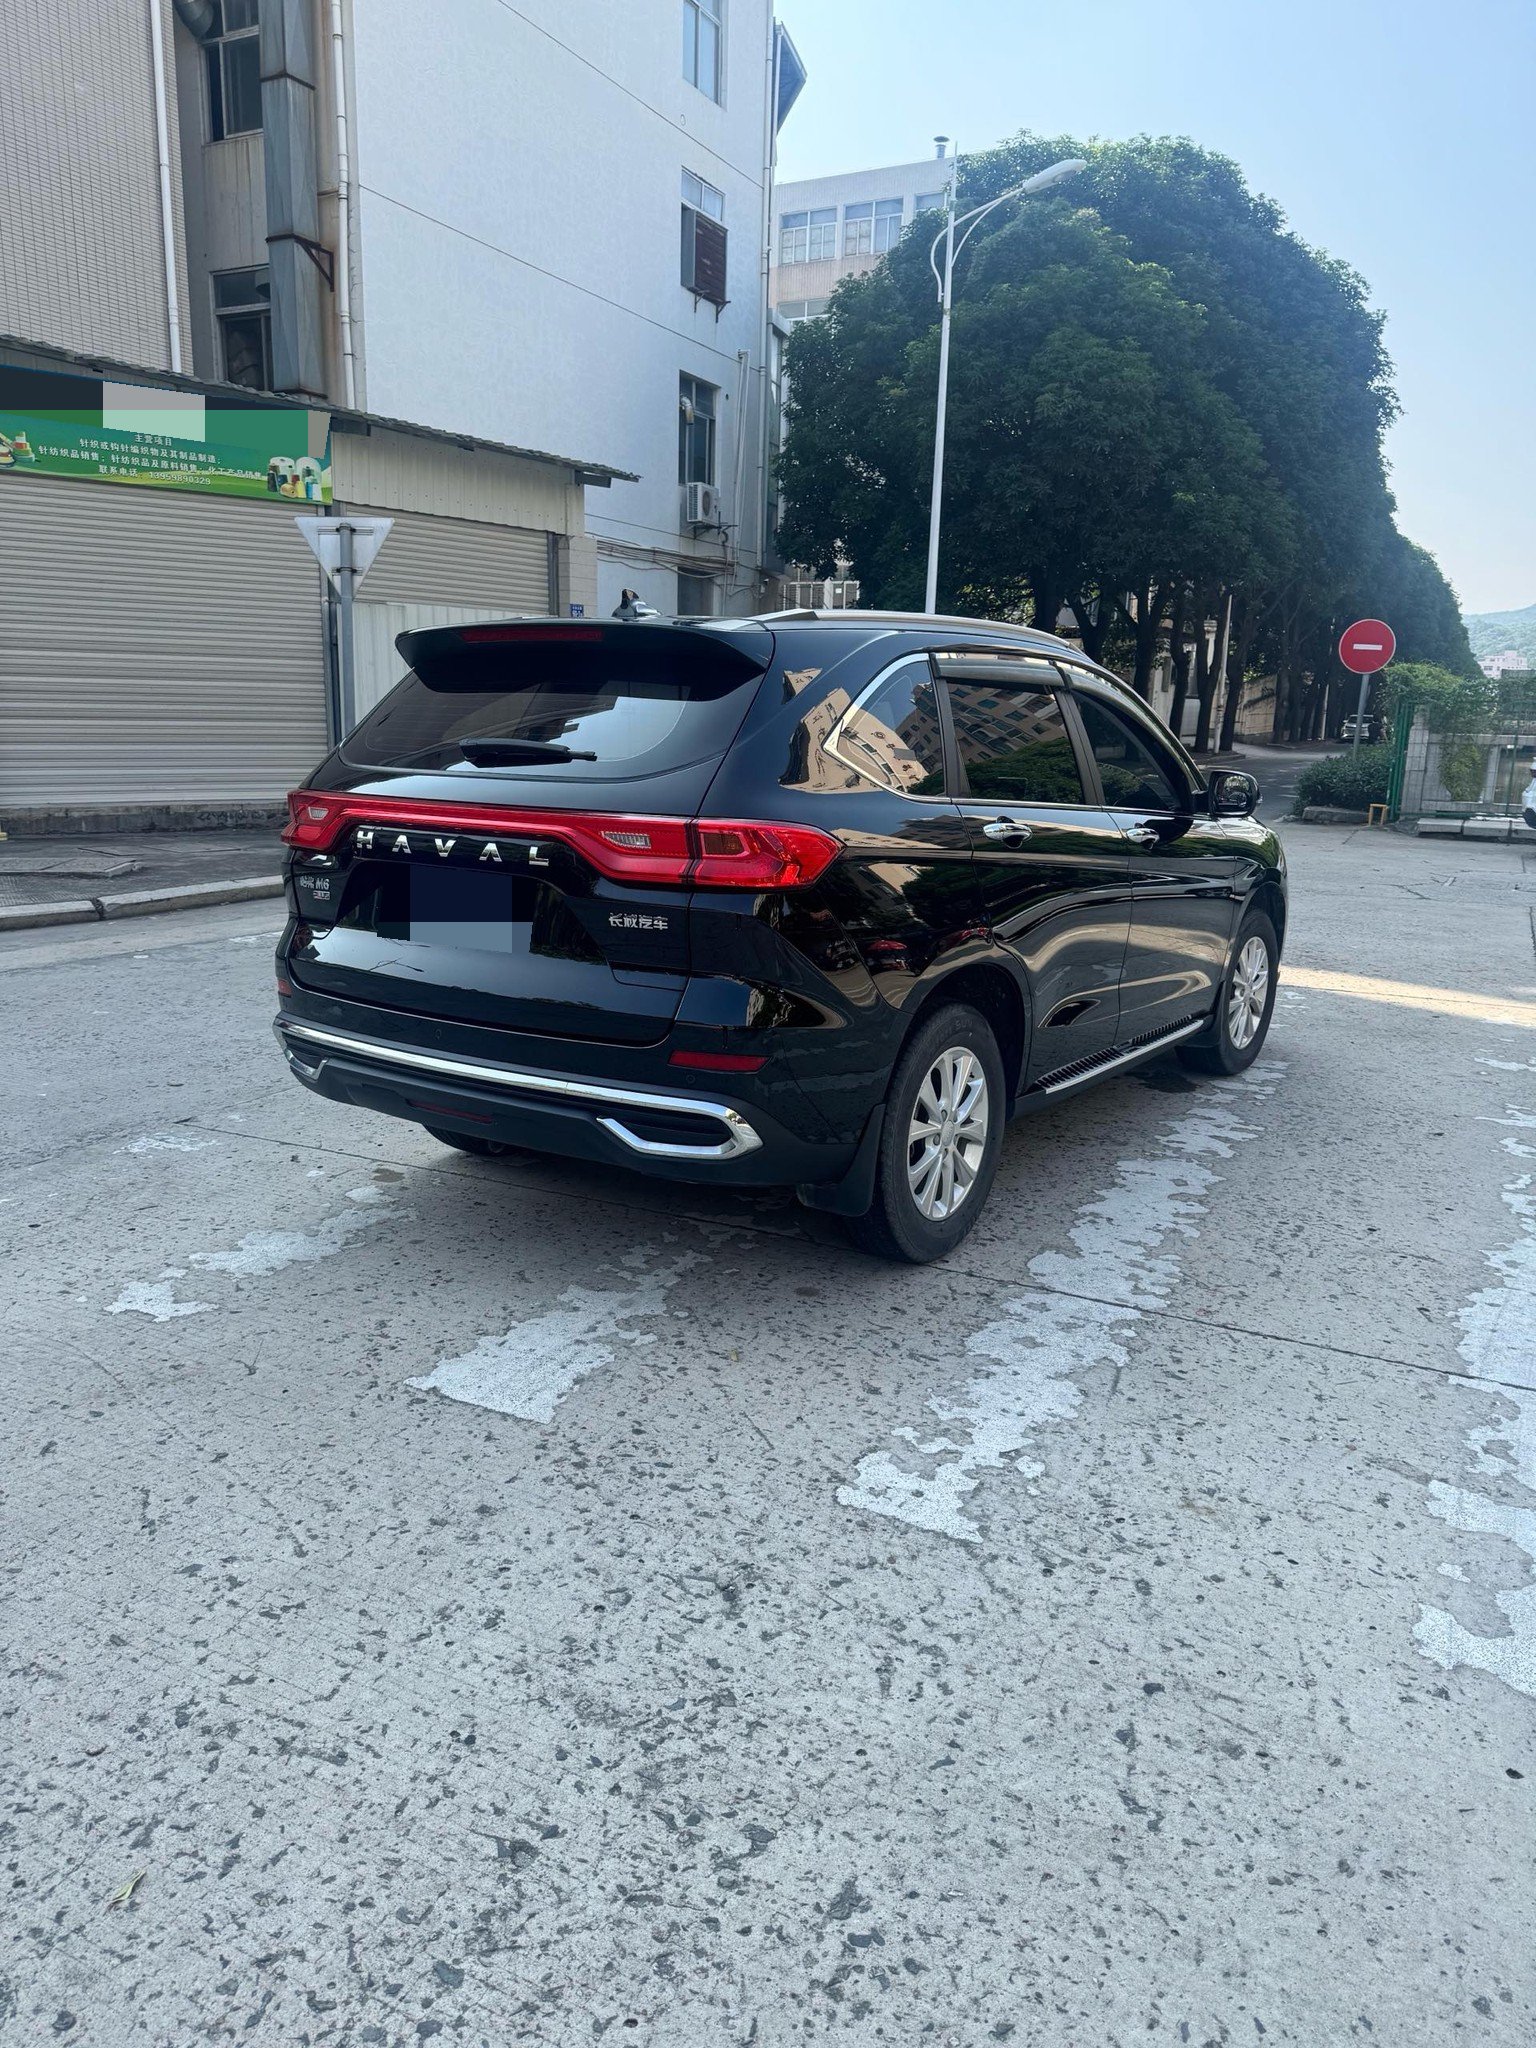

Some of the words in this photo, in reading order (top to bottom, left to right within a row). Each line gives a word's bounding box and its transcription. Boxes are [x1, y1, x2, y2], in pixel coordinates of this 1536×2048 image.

[134, 434, 172, 447] 主营项目
[356, 830, 550, 867] HAVAL
[315, 877, 330, 891] M6
[608, 912, 669, 931] 长城汽车
